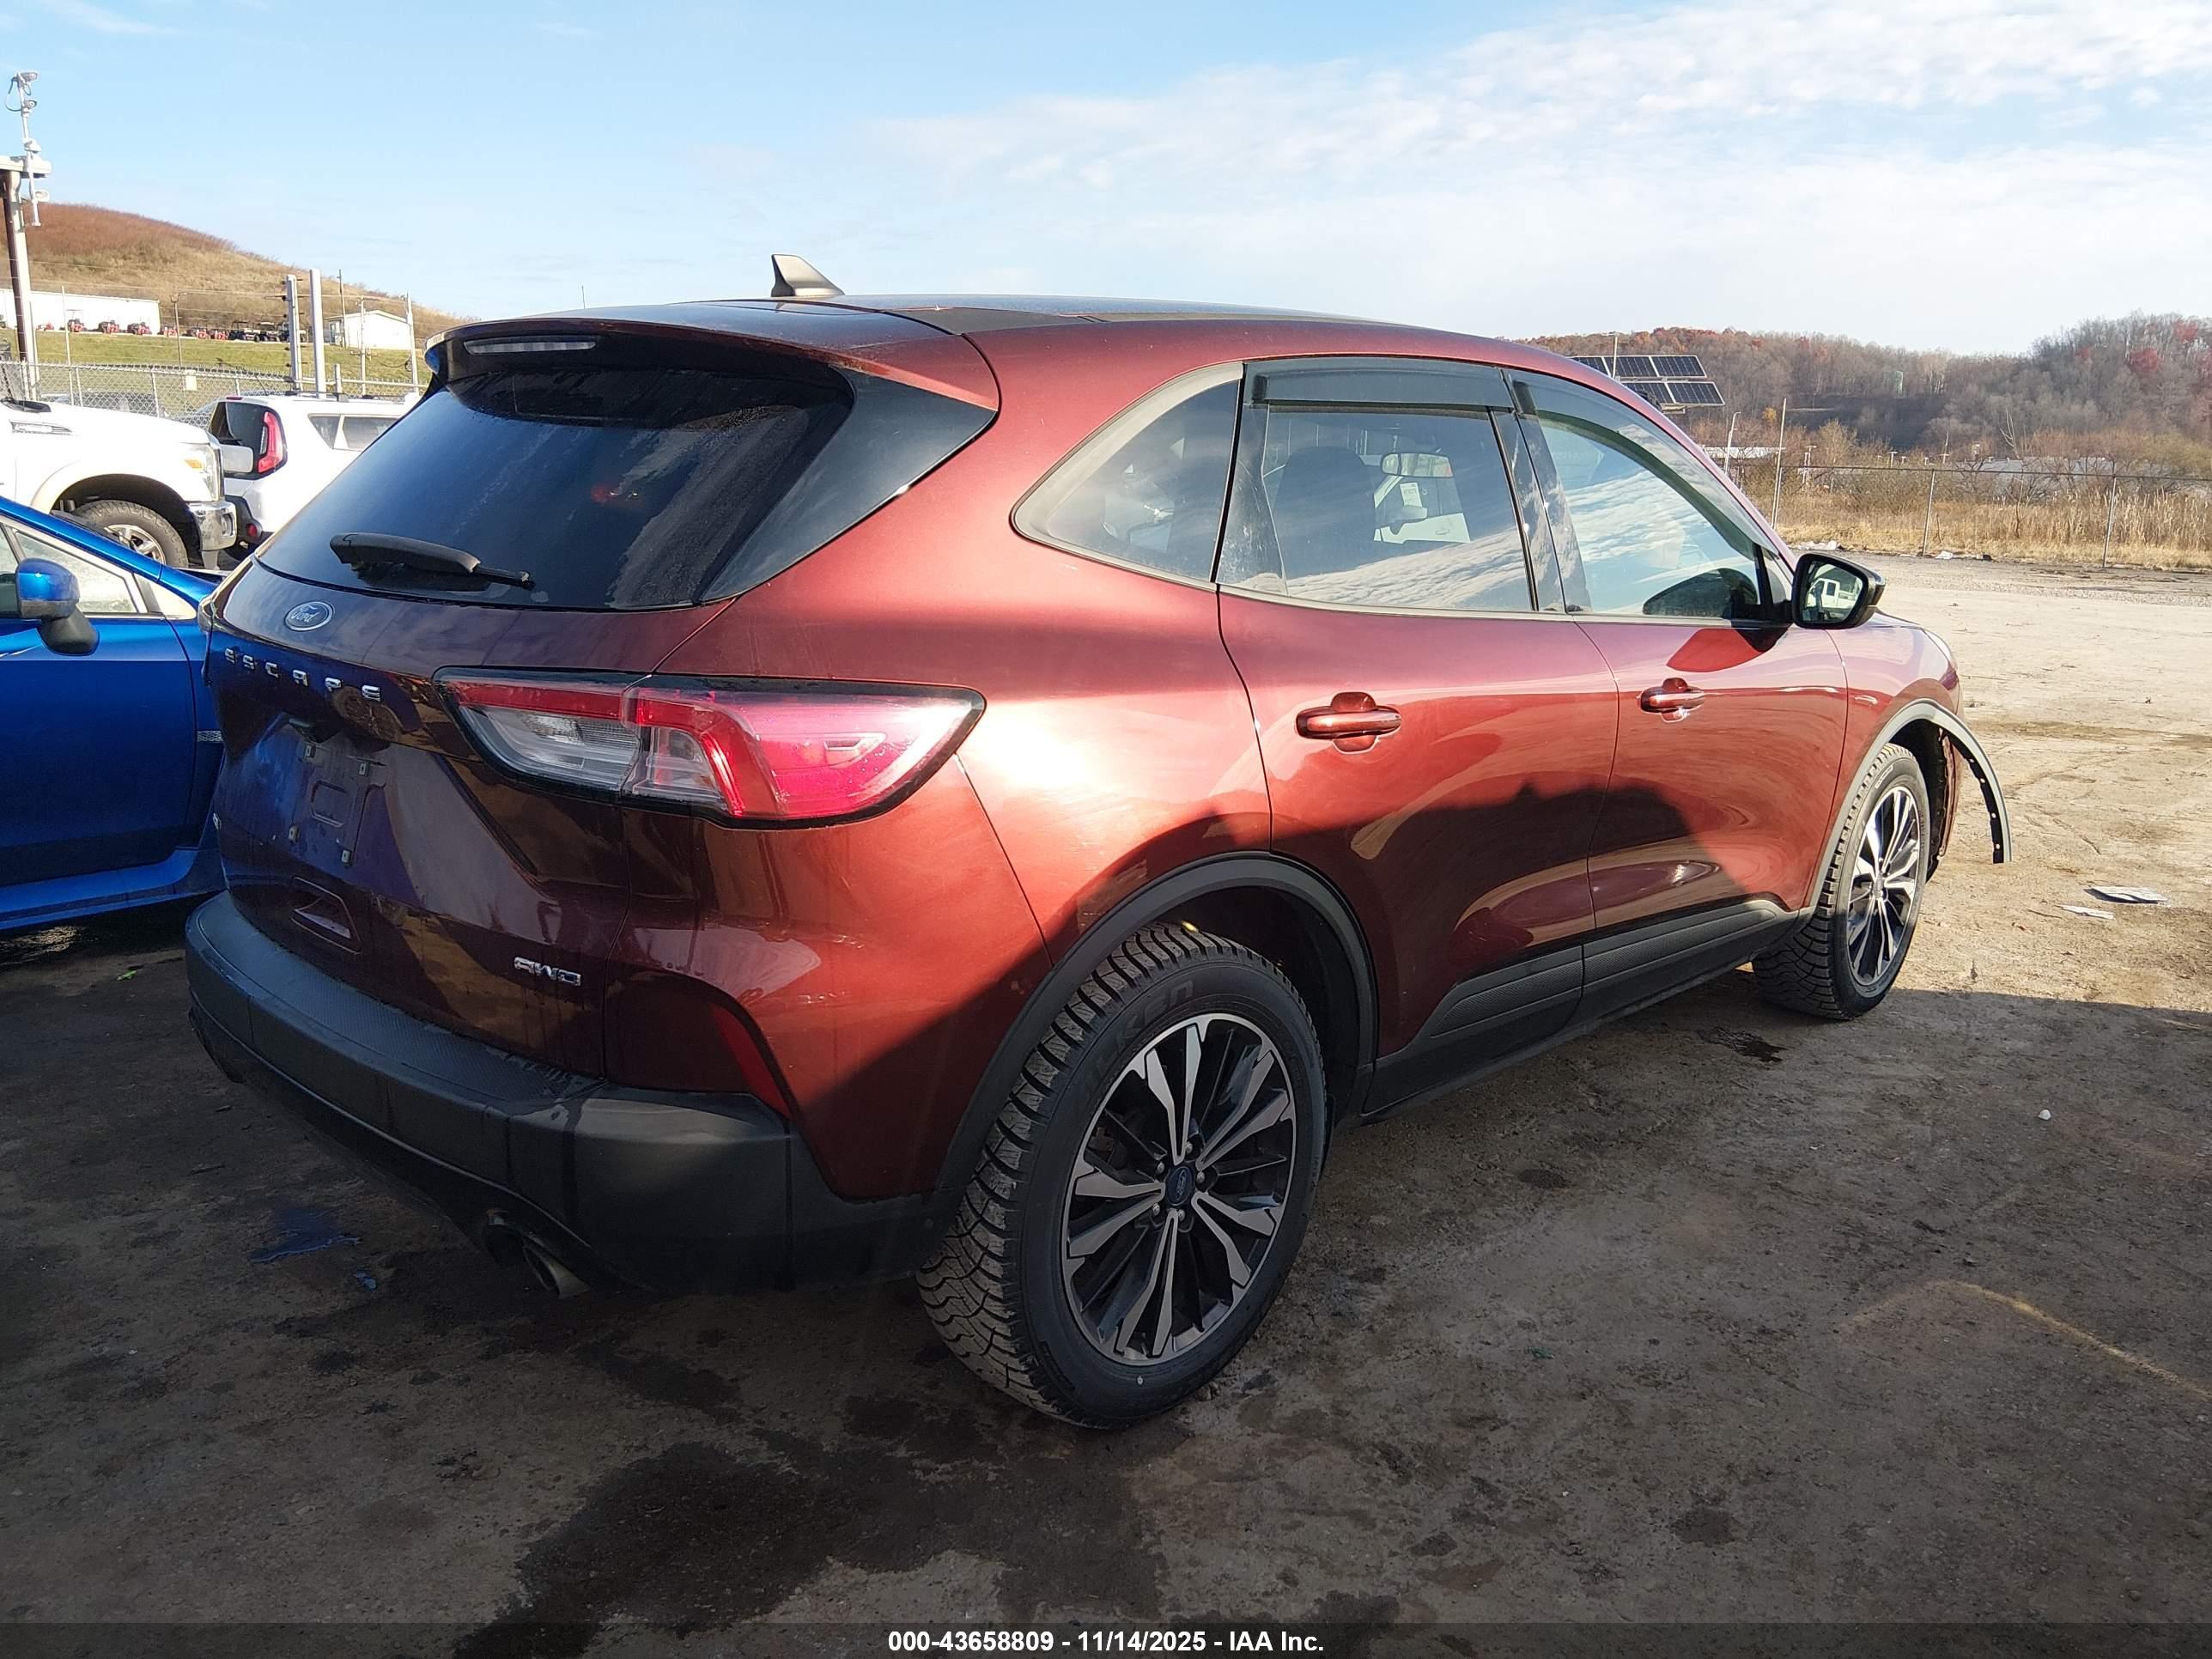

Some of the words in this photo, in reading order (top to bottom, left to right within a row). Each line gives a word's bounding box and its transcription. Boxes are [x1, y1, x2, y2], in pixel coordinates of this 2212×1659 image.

[289, 603, 319, 622] Ford
[224, 647, 381, 702] ESCAPE
[514, 957, 581, 986] AWD
